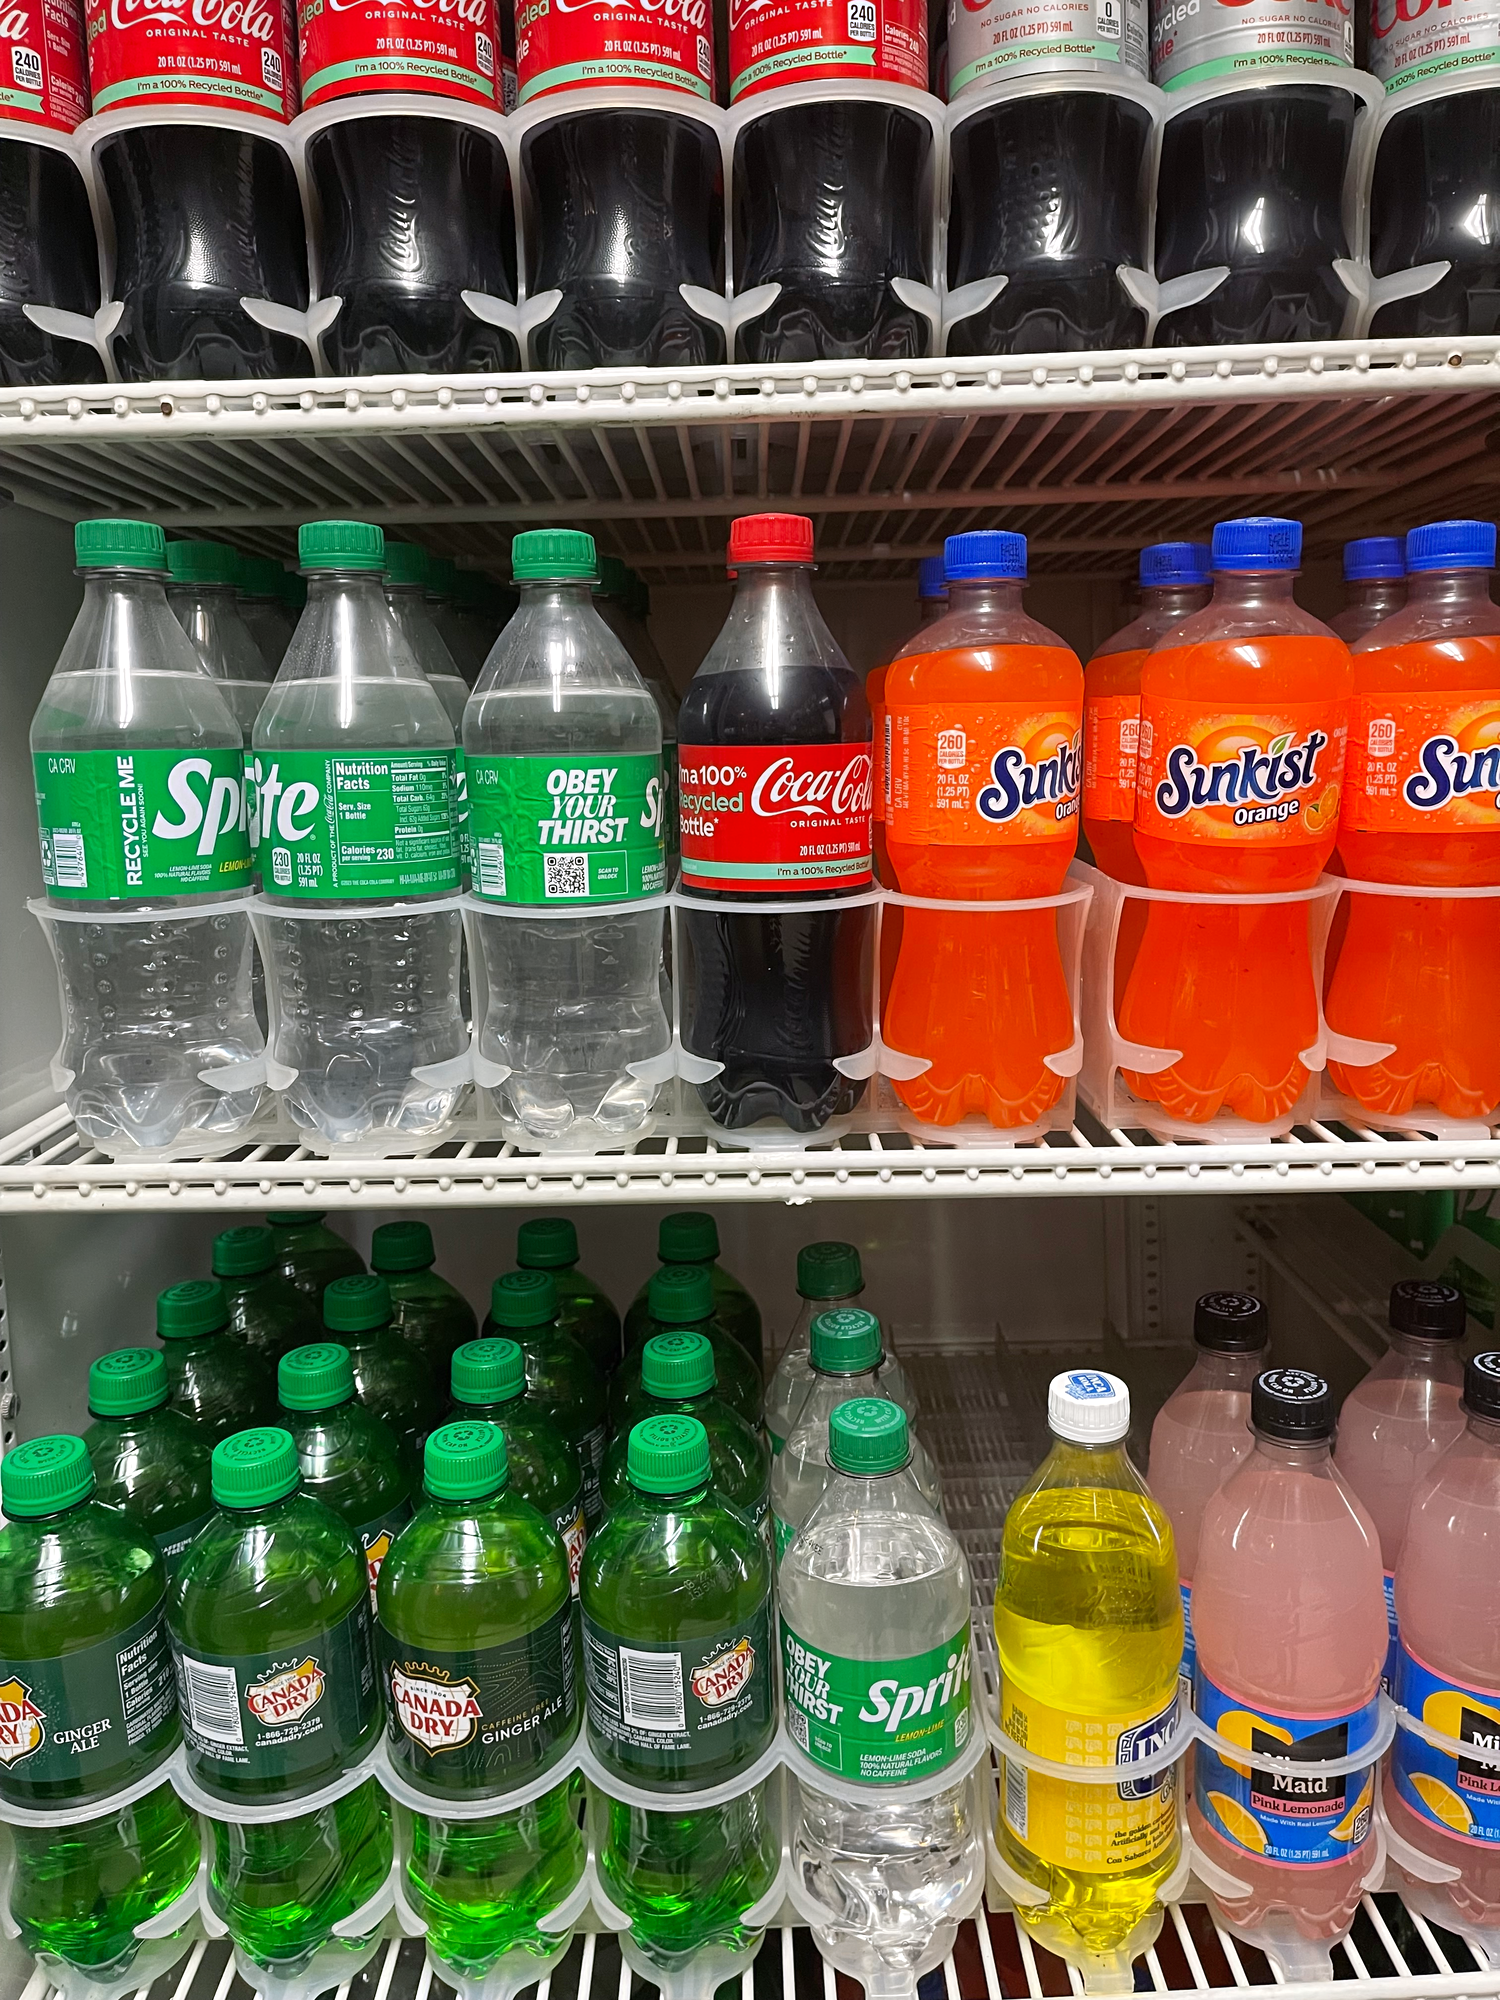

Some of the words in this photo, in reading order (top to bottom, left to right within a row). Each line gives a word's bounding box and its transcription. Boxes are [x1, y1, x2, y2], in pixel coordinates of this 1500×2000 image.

[745, 9, 790, 29] ORIGINAL
[795, 0, 833, 12] TASTE
[850, 4, 874, 22] 240
[994, 9, 1023, 23] SUGAR
[1027, 6, 1039, 14] NO
[1045, 4, 1088, 13] CALORIES
[1105, 2, 1111, 17] 0
[365, 11, 425, 20] ORIGINAL
[431, 15, 465, 30] TASTE
[594, 13, 652, 23] ORIGINAL
[658, 17, 688, 34] TASTE
[849, 22, 875, 31] CALORIES
[1259, 15, 1290, 23] SUGAR
[1293, 15, 1305, 23] NO
[1308, 17, 1340, 31] CALORIES
[146, 29, 207, 38] ORIGINAL
[213, 31, 249, 47] TASTE
[377, 38, 385, 49] 20
[387, 39, 394, 49] FL
[396, 39, 404, 50] OZ
[406, 40, 422, 51] (1.25
[425, 41, 435, 53] PT)
[437, 43, 447, 55] 591
[448, 46, 457, 58] mL
[477, 36, 492, 57] 240
[15, 51, 38, 71] 240
[263, 51, 280, 71] 240
[355, 64, 367, 72] I'm
[379, 61, 405, 71] 100%
[407, 63, 449, 77] Recycled
[975, 64, 986, 73] I'm
[994, 52, 1017, 65] 100%
[1019, 45, 1062, 58] Recycled
[1371, 724, 1392, 738] 260
[940, 735, 963, 750] 260
[49, 758, 58, 773] CA
[60, 758, 75, 774] CRV
[117, 755, 135, 788] ME
[336, 762, 388, 775] Nutrition
[1155, 729, 1328, 819] Sunkist
[337, 777, 370, 790] Facts
[476, 770, 484, 784] CA
[485, 770, 498, 784] CRV
[546, 769, 618, 794] OBEY
[137, 783, 145, 806] SOON!
[895, 797, 902, 808] CA
[937, 787, 955, 798] (1.25
[958, 787, 970, 798] PT)
[339, 802, 356, 811] Serv.
[358, 802, 371, 810] Size
[552, 794, 616, 818] YOUR
[937, 799, 950, 808] 591
[952, 800, 964, 808] mL
[1233, 799, 1300, 827] Orange
[538, 818, 629, 845] THIRST
[790, 819, 841, 828] ORIGINAL
[845, 816, 865, 824] TASTE
[121, 793, 142, 885] RECYCLE
[331, 842, 335, 851] OF
[274, 852, 289, 867] 230
[342, 846, 375, 855] Calories
[376, 848, 394, 860] 230
[298, 877, 309, 887] 591
[309, 878, 317, 887] mL
[119, 1631, 158, 1664] Nutrition
[786, 1635, 831, 1679] OBEY
[121, 1653, 147, 1677] Facts
[692, 1647, 755, 1697] CANADA
[715, 1671, 745, 1699] DRY
[789, 1655, 830, 1700] YOUR
[248, 1667, 324, 1714] CANADA
[391, 1679, 483, 1718] CANADA
[411, 1686, 428, 1694] SINCE
[430, 1690, 447, 1698] 1904
[786, 1667, 843, 1726] THIRST
[272, 1688, 310, 1718] DRY
[410, 1712, 454, 1737] DRY
[481, 1711, 527, 1731] CAFFEINE
[531, 1698, 549, 1714] FREE
[481, 1716, 540, 1744] GINGER
[543, 1695, 562, 1720] ALE
[697, 1700, 753, 1730] canadadry.com
[53, 1719, 112, 1744] GINGER
[256, 1723, 323, 1746] canadadry.com
[257, 1717, 320, 1740] 1-866-729-2379
[895, 1719, 945, 1743] LEMON-LIME
[71, 1736, 100, 1754] ALE
[860, 1751, 906, 1762] LEMON-LIME
[907, 1748, 926, 1760] SODA
[860, 1761, 880, 1769] 100%
[881, 1760, 913, 1769] NATURAL
[914, 1747, 942, 1767] FLAVORS
[872, 1768, 907, 1777] CAFFEINE
[1459, 1774, 1488, 1790] Pink
[1253, 1795, 1280, 1811] Pink
[1283, 1800, 1343, 1814] Lemonade
[1260, 1814, 1278, 1824] Made
[1280, 1819, 1296, 1827] With
[1313, 1818, 1336, 1827] Lemons
[1111, 1832, 1148, 1847] Artificially
